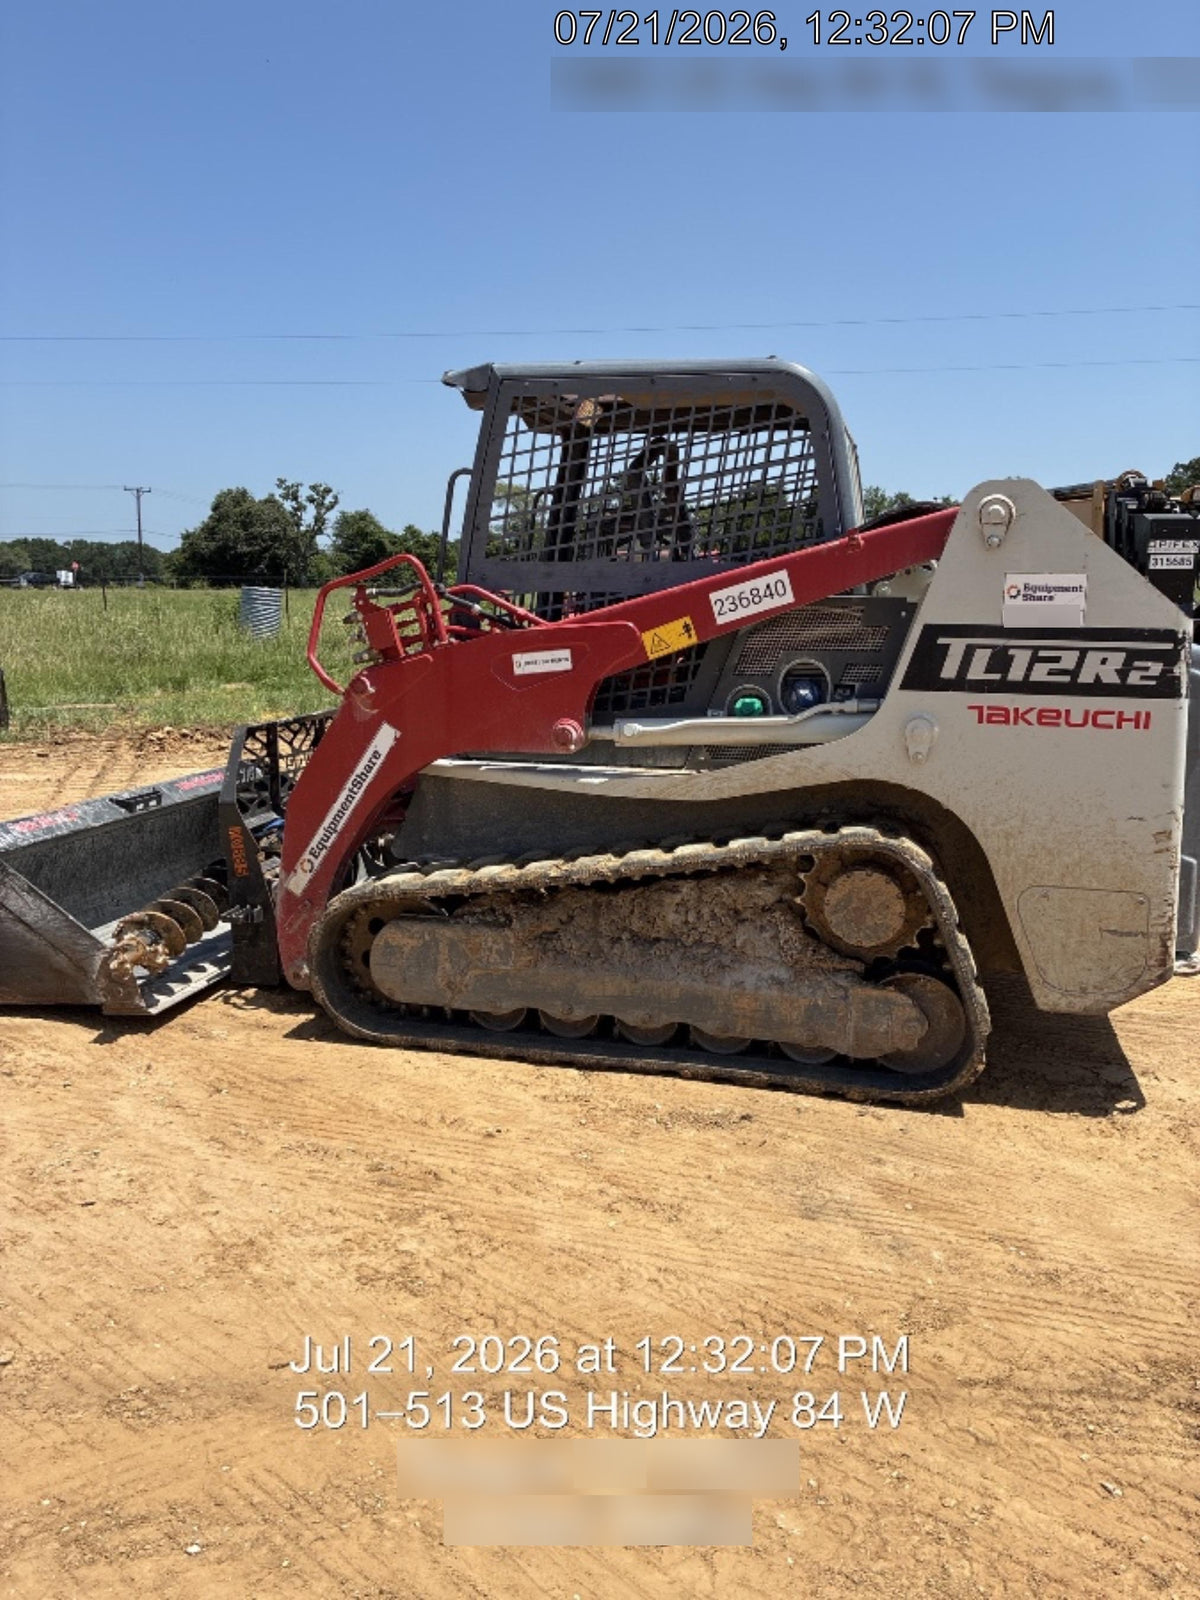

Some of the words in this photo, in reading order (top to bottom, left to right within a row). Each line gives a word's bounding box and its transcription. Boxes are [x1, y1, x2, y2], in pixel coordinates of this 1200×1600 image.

[714, 579, 786, 616] 236840
[1022, 593, 1055, 602] Share
[1023, 582, 1084, 594] Equipment
[937, 638, 1164, 685] TL12R2
[309, 750, 382, 860] EquipmentShare
